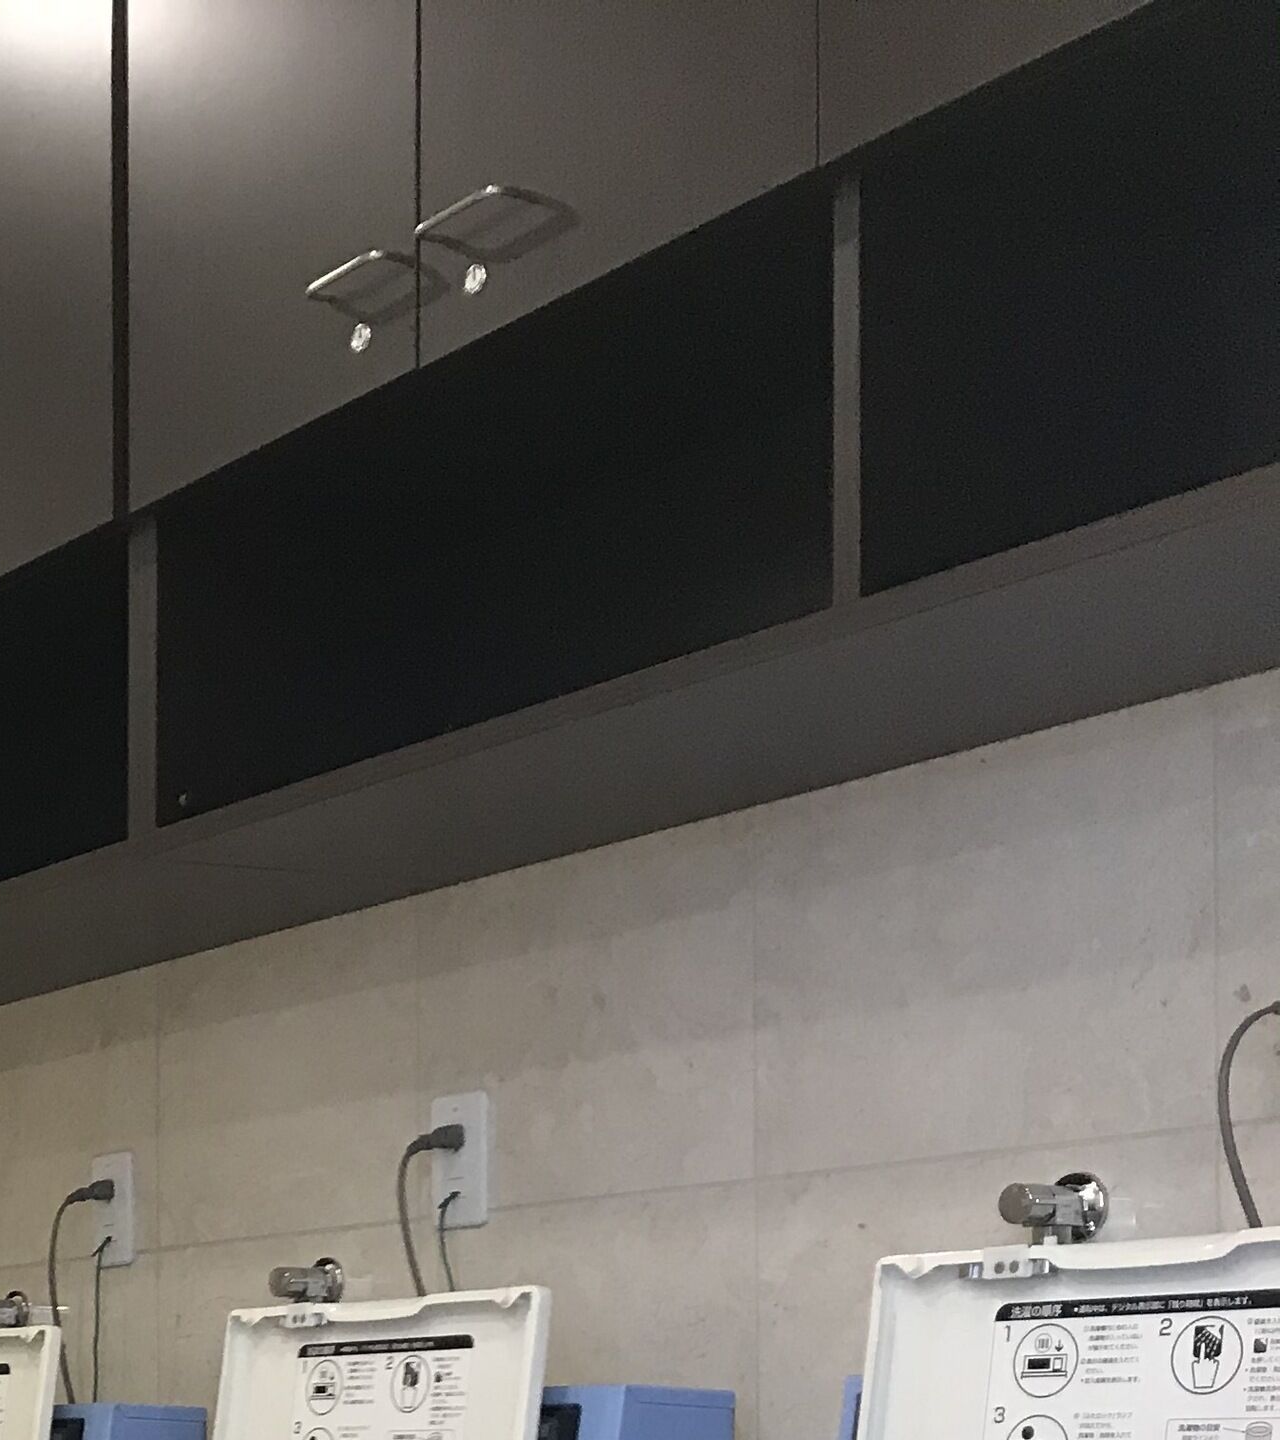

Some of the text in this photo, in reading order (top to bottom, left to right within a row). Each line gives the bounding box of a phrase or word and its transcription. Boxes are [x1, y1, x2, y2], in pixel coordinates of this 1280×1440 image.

[1005, 1324, 1011, 1343] 1
[1159, 1317, 1173, 1337] 2
[993, 1406, 1006, 1424] 3
